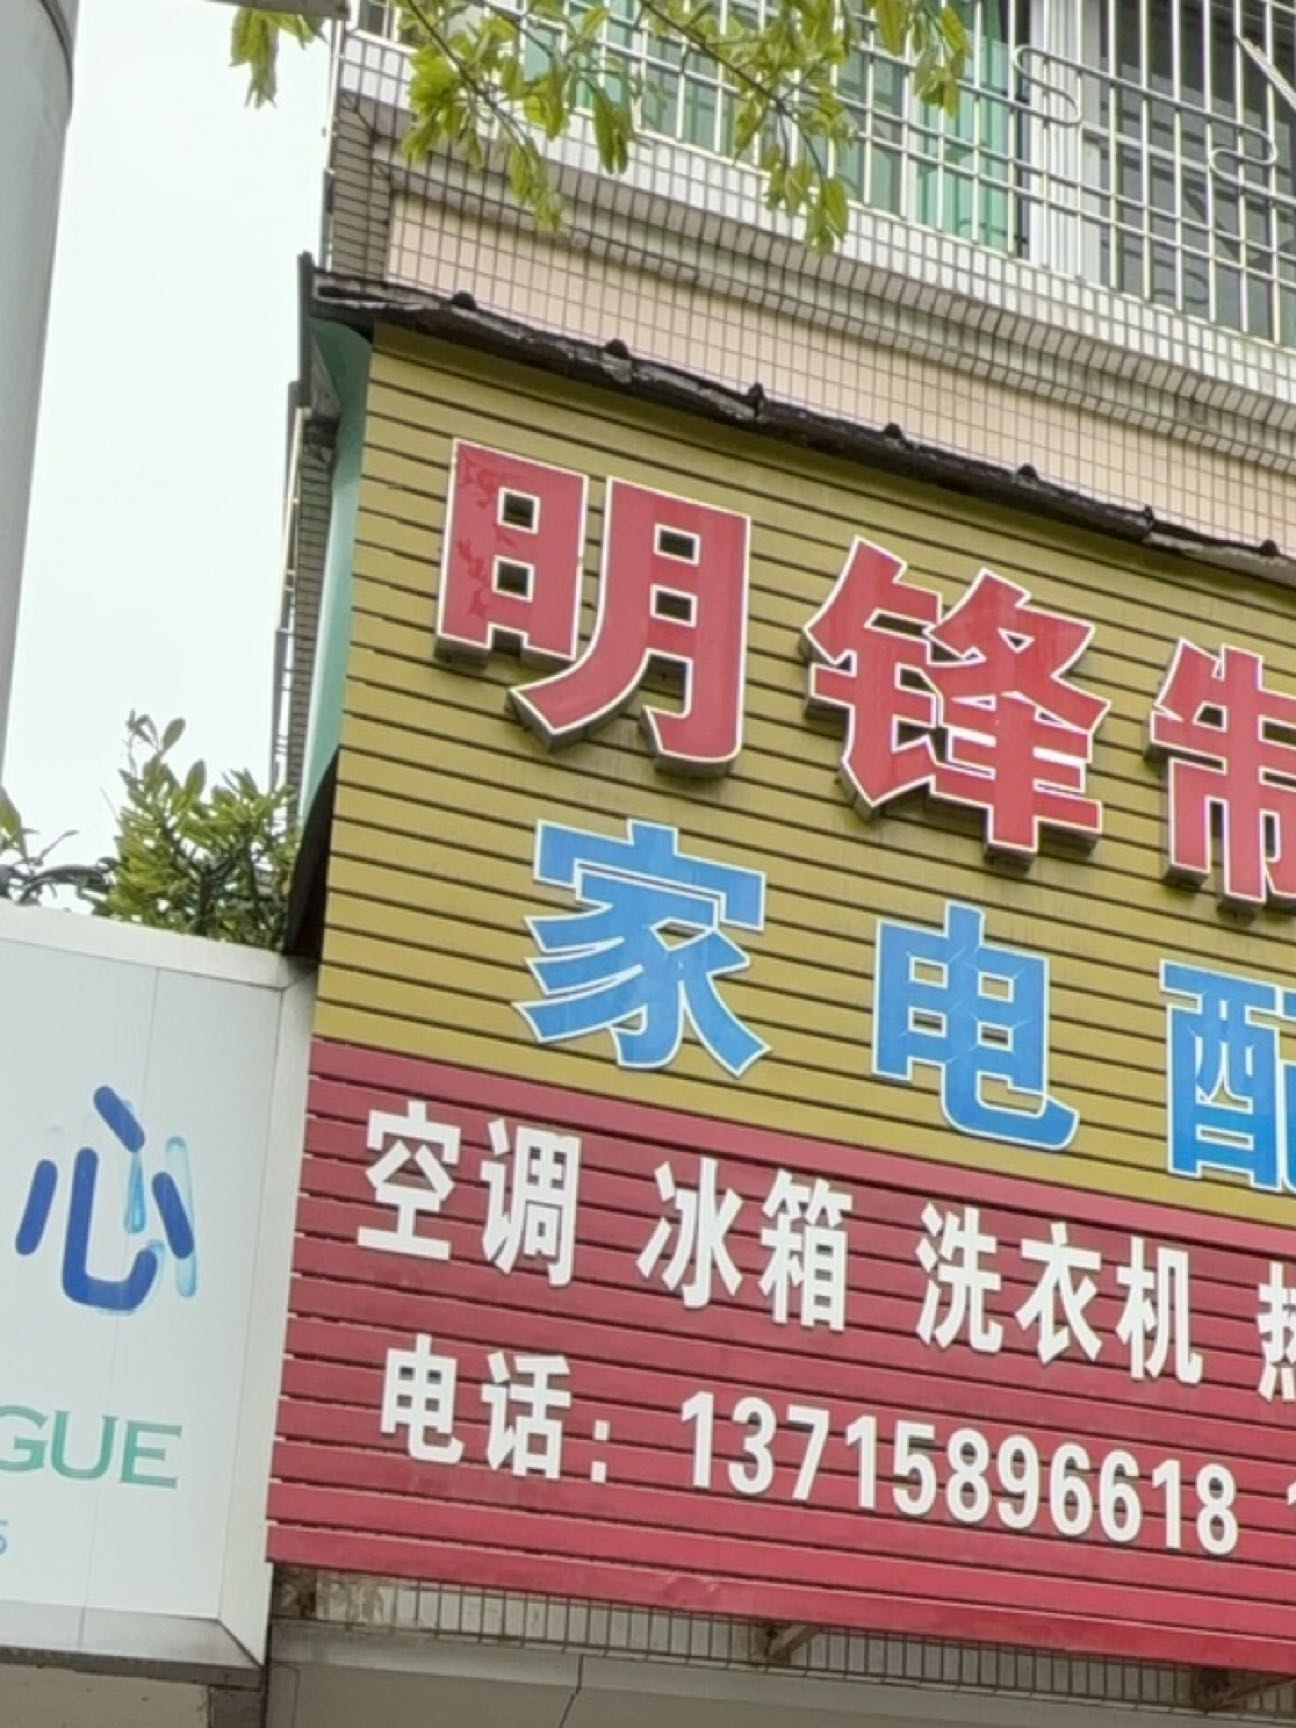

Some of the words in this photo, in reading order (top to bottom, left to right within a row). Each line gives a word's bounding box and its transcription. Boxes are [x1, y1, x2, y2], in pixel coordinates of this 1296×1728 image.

[14, 1085, 197, 1316] 心
[357, 1100, 582, 1287] 空调
[636, 1155, 853, 1333] 冰箱
[915, 1202, 1203, 1386] 洗衣机
[0, 1404, 183, 1490] GUE
[681, 1390, 1239, 1556] 13715896618
